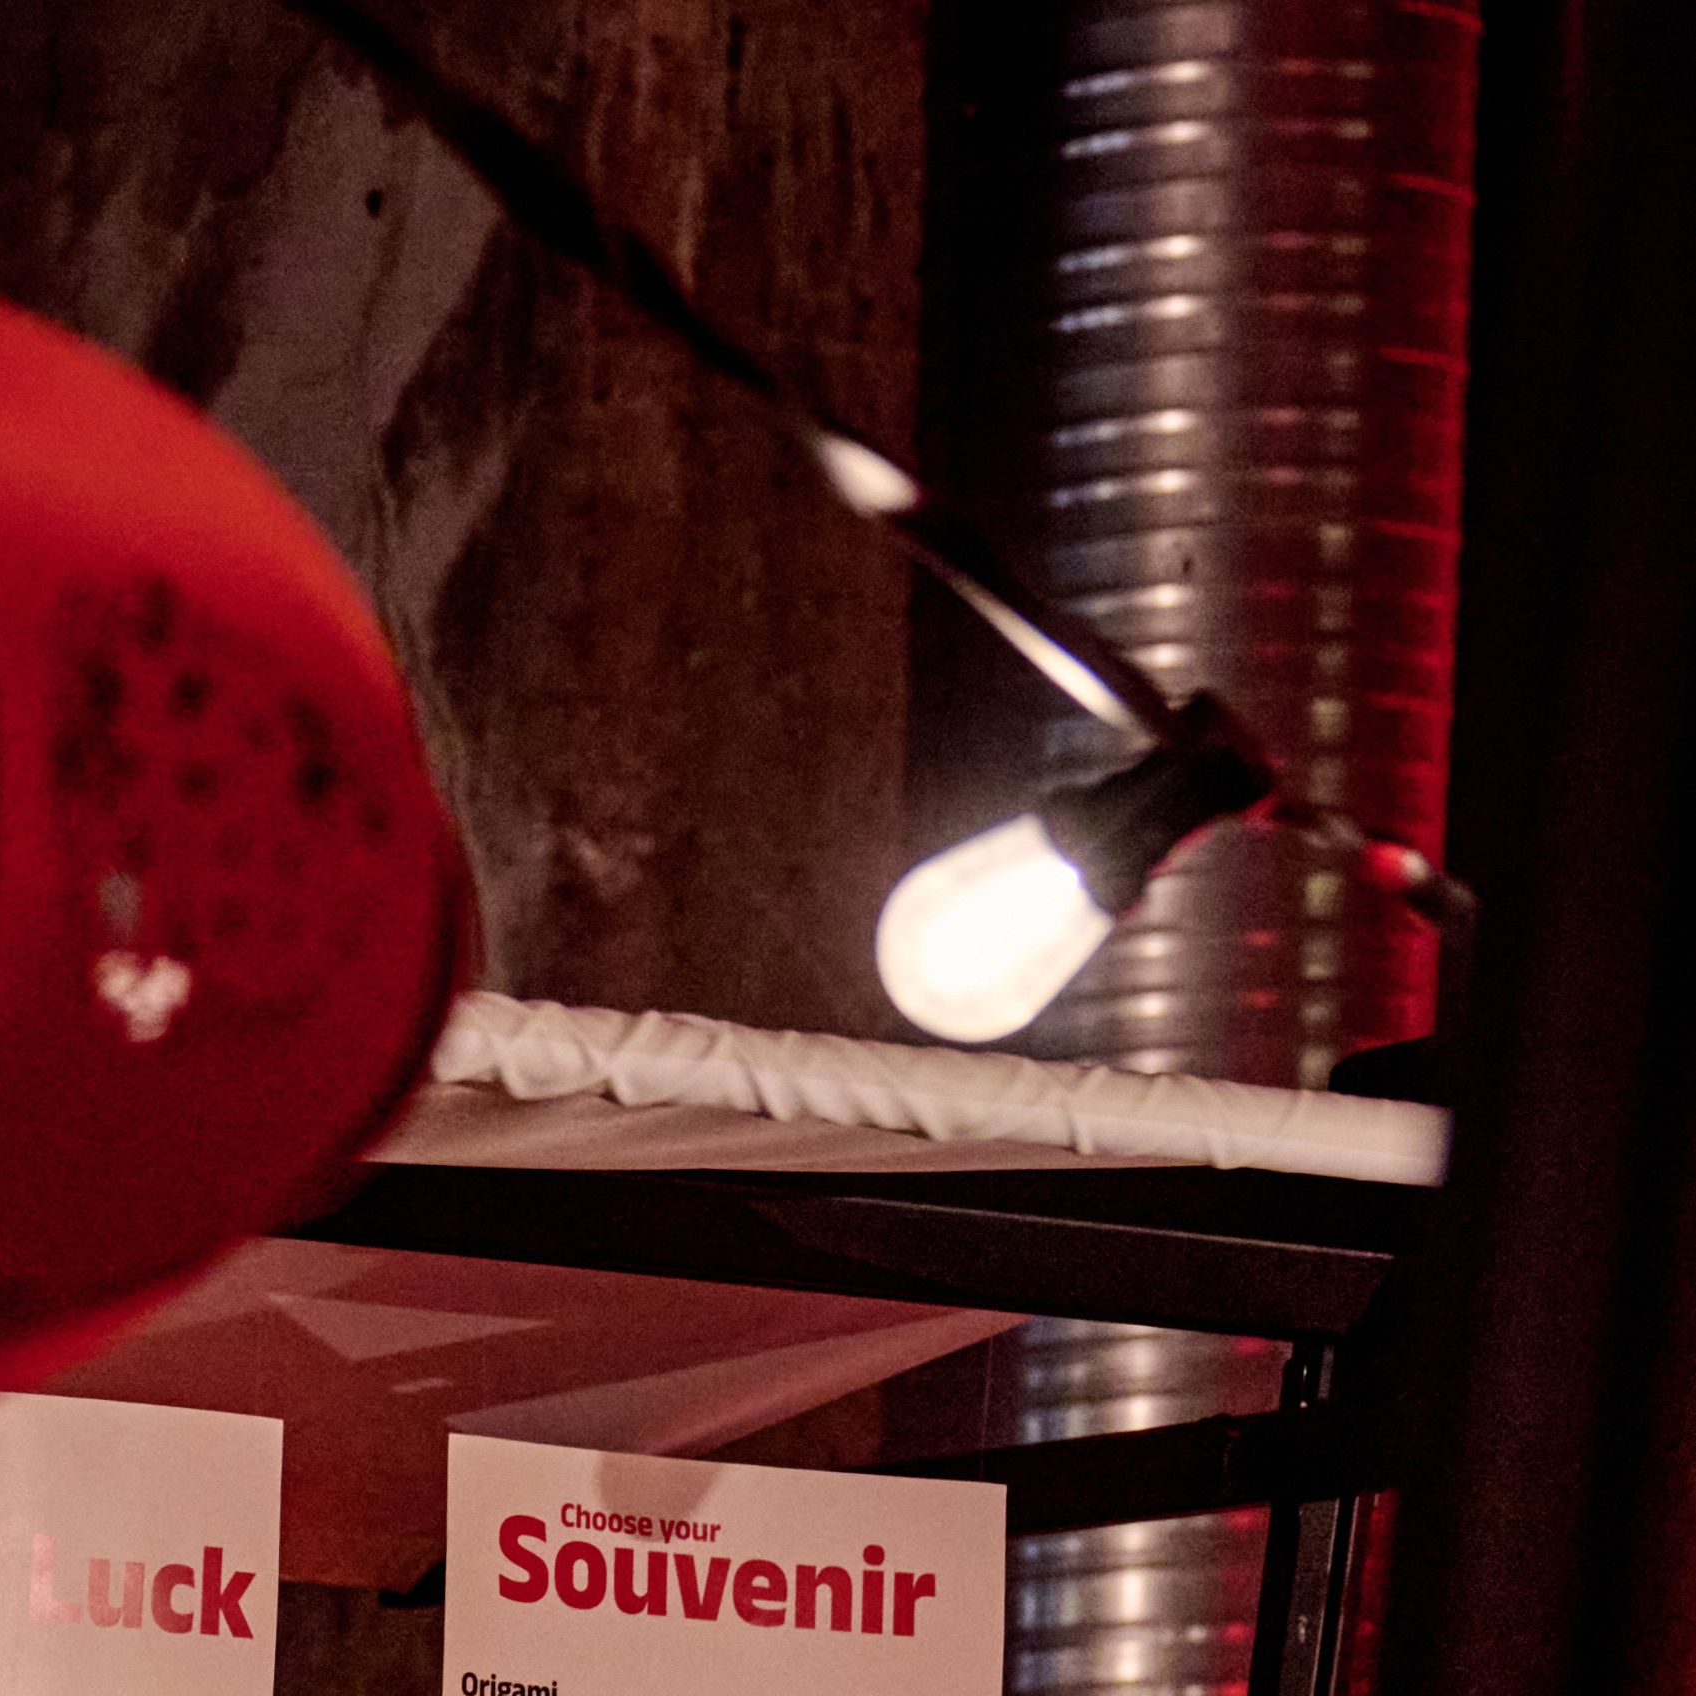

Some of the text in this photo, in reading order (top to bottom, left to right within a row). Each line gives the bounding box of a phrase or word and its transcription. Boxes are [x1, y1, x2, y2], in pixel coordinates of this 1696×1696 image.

[560, 1502, 721, 1544] Choose your
[29, 1534, 256, 1639] Luck
[498, 1514, 937, 1638] Souvenir
